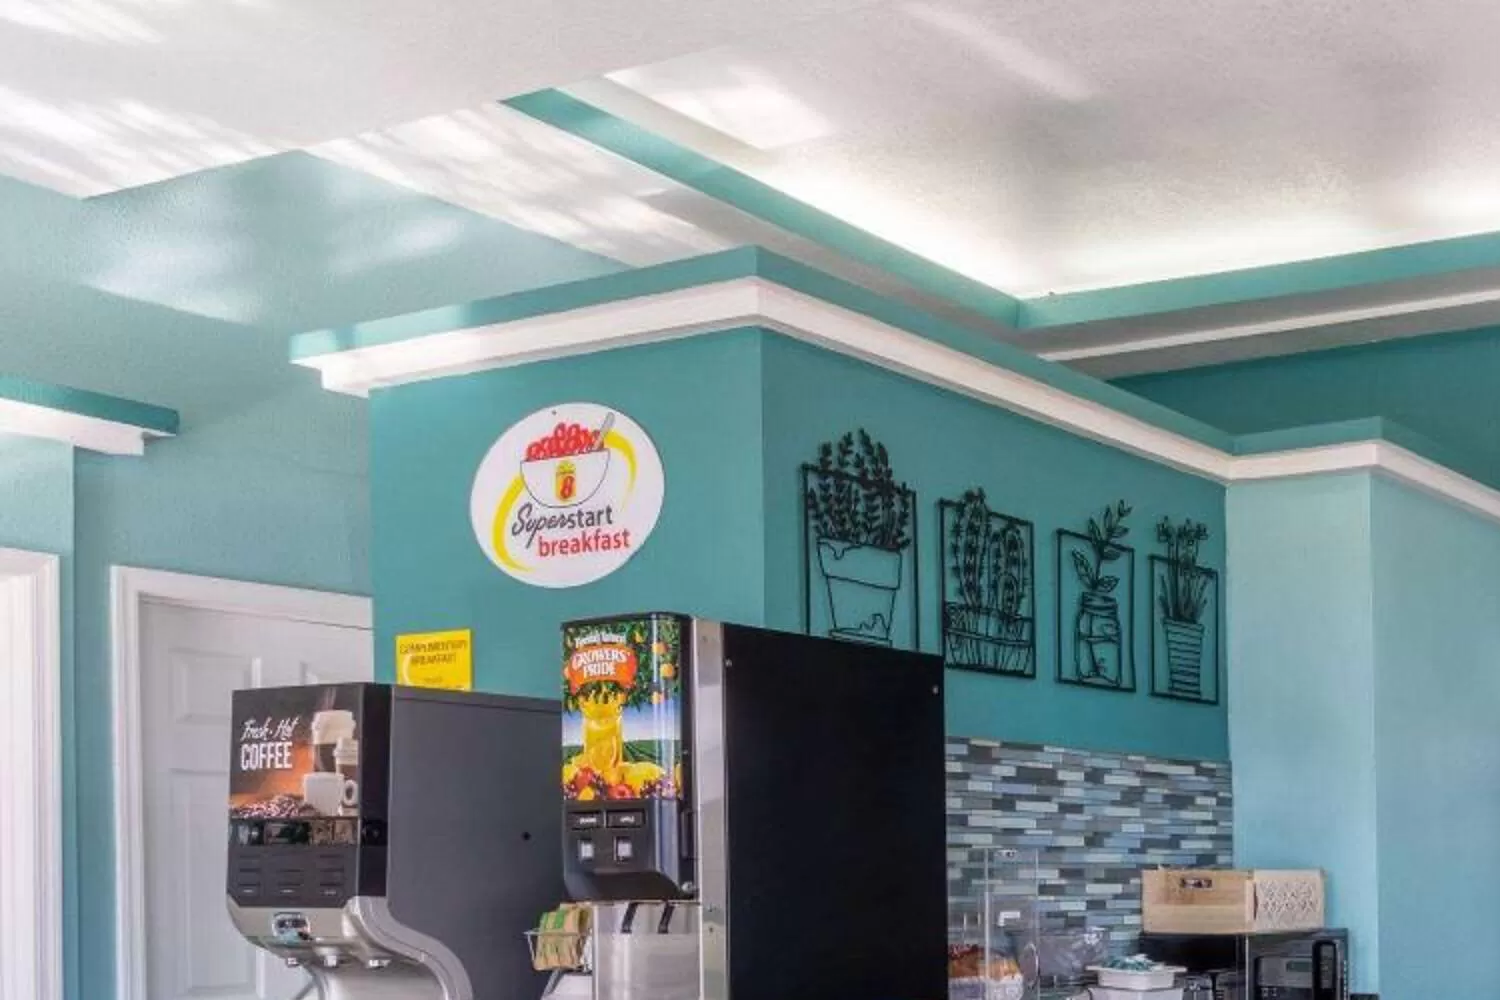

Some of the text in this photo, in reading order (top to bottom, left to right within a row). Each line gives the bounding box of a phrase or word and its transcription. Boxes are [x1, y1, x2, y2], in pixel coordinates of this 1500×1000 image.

[561, 474, 575, 499] 8
[511, 502, 613, 550] Superstart
[538, 528, 630, 557] breakfast
[240, 715, 300, 741] Fresh Hot
[241, 741, 293, 770] COFFEE
